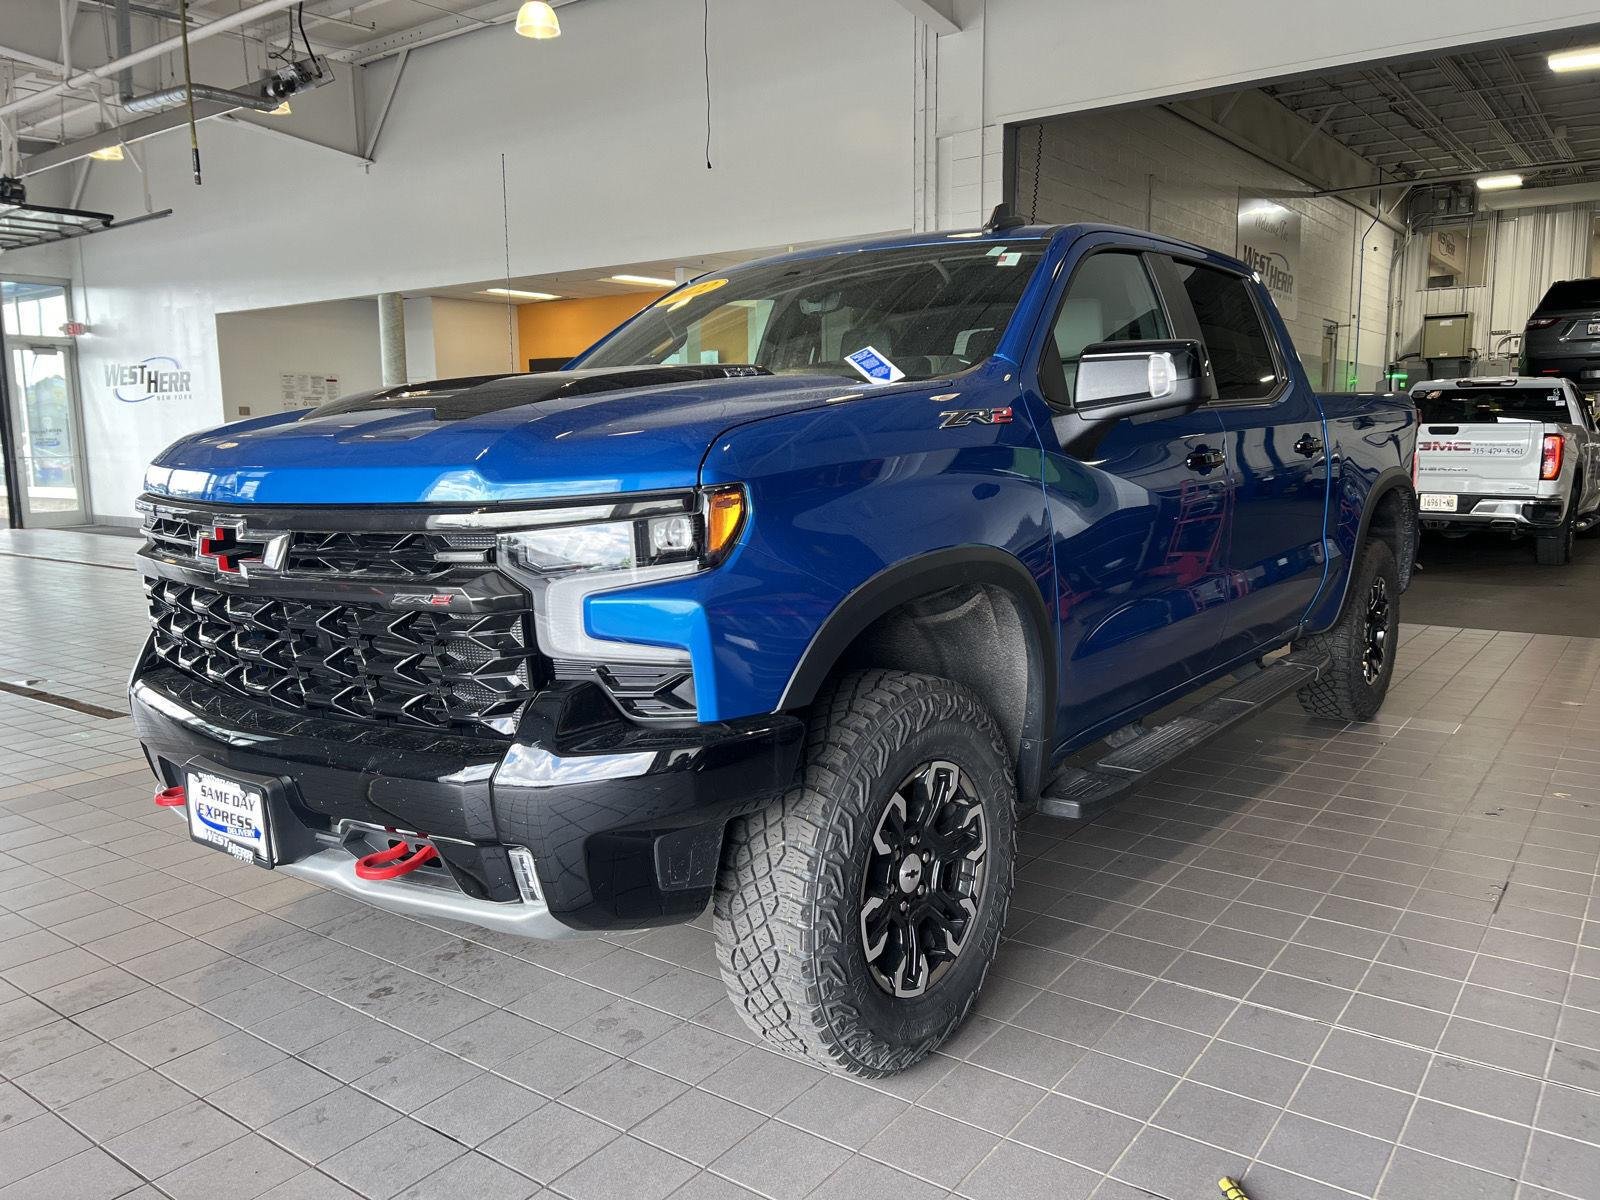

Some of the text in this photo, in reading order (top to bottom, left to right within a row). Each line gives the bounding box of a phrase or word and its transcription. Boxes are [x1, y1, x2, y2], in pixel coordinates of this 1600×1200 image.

[1243, 245, 1294, 294] WEST HERR
[104, 364, 191, 393] WEST HERR
[939, 406, 1012, 430] ZR2
[201, 785, 256, 812] SAME DAY
[198, 803, 253, 830] EXPRESS
[204, 829, 230, 848] WEST
[227, 841, 254, 860] HERR
